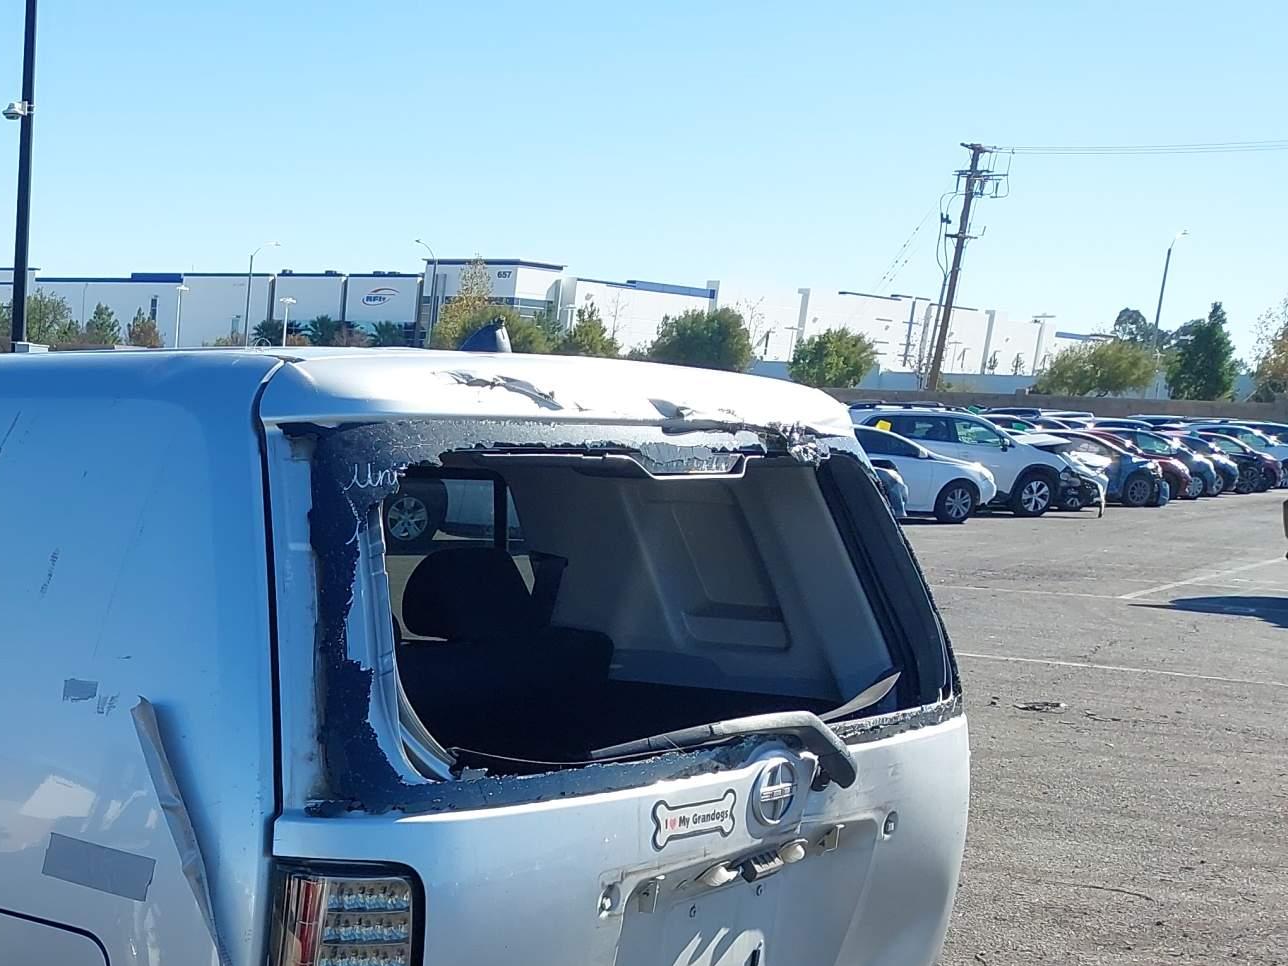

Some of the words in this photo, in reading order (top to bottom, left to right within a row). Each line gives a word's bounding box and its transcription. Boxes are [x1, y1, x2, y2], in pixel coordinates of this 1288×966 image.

[497, 270, 513, 279] 657
[678, 815, 690, 829] My
[692, 809, 729, 825] Grandogs
